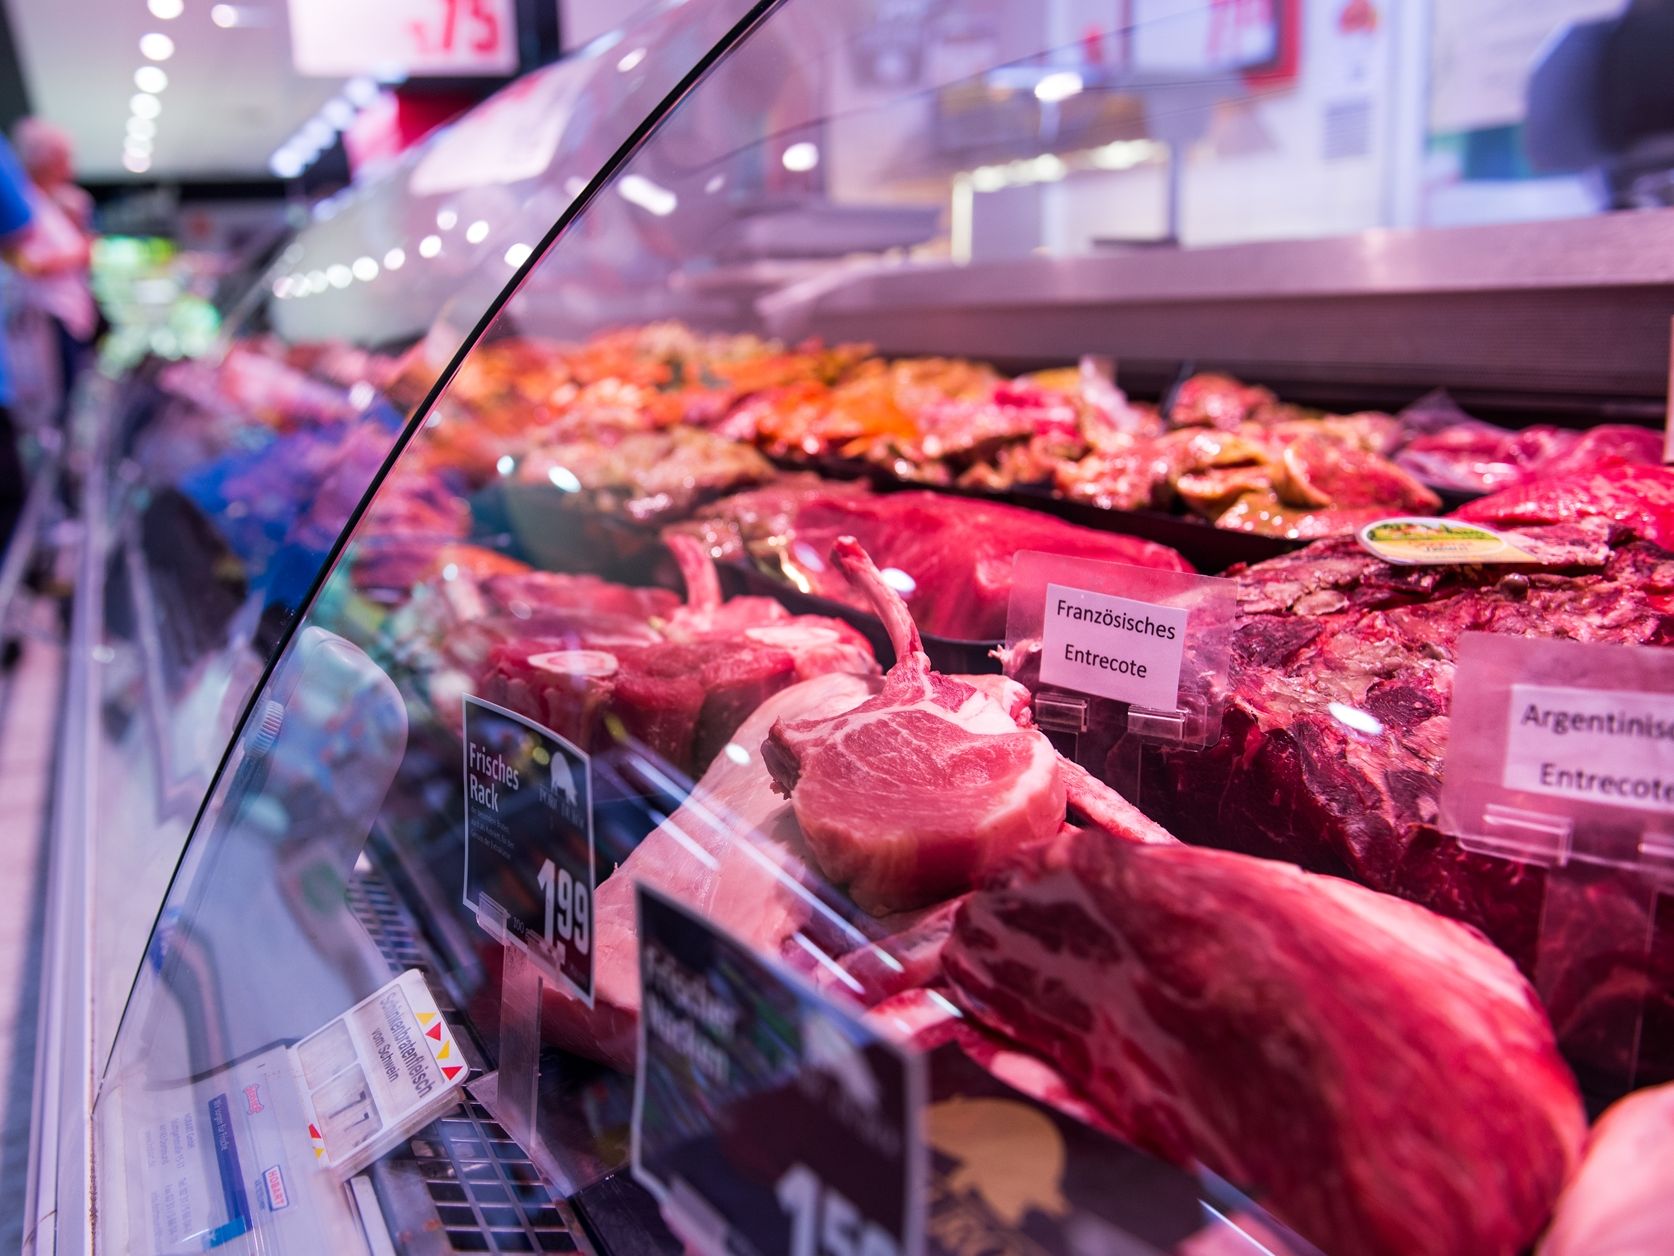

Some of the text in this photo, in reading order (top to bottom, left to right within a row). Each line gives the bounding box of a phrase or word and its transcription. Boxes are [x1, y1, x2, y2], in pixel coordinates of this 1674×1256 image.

[1057, 599, 1176, 640] Französisches
[1064, 643, 1148, 679] Entrecote
[469, 742, 520, 791] Frisches
[469, 773, 499, 812] Rack
[372, 1027, 399, 1082] vom Schwein
[379, 991, 436, 1098] Schinkenbratenfleisch
[268, 1169, 285, 1206] HOBART
